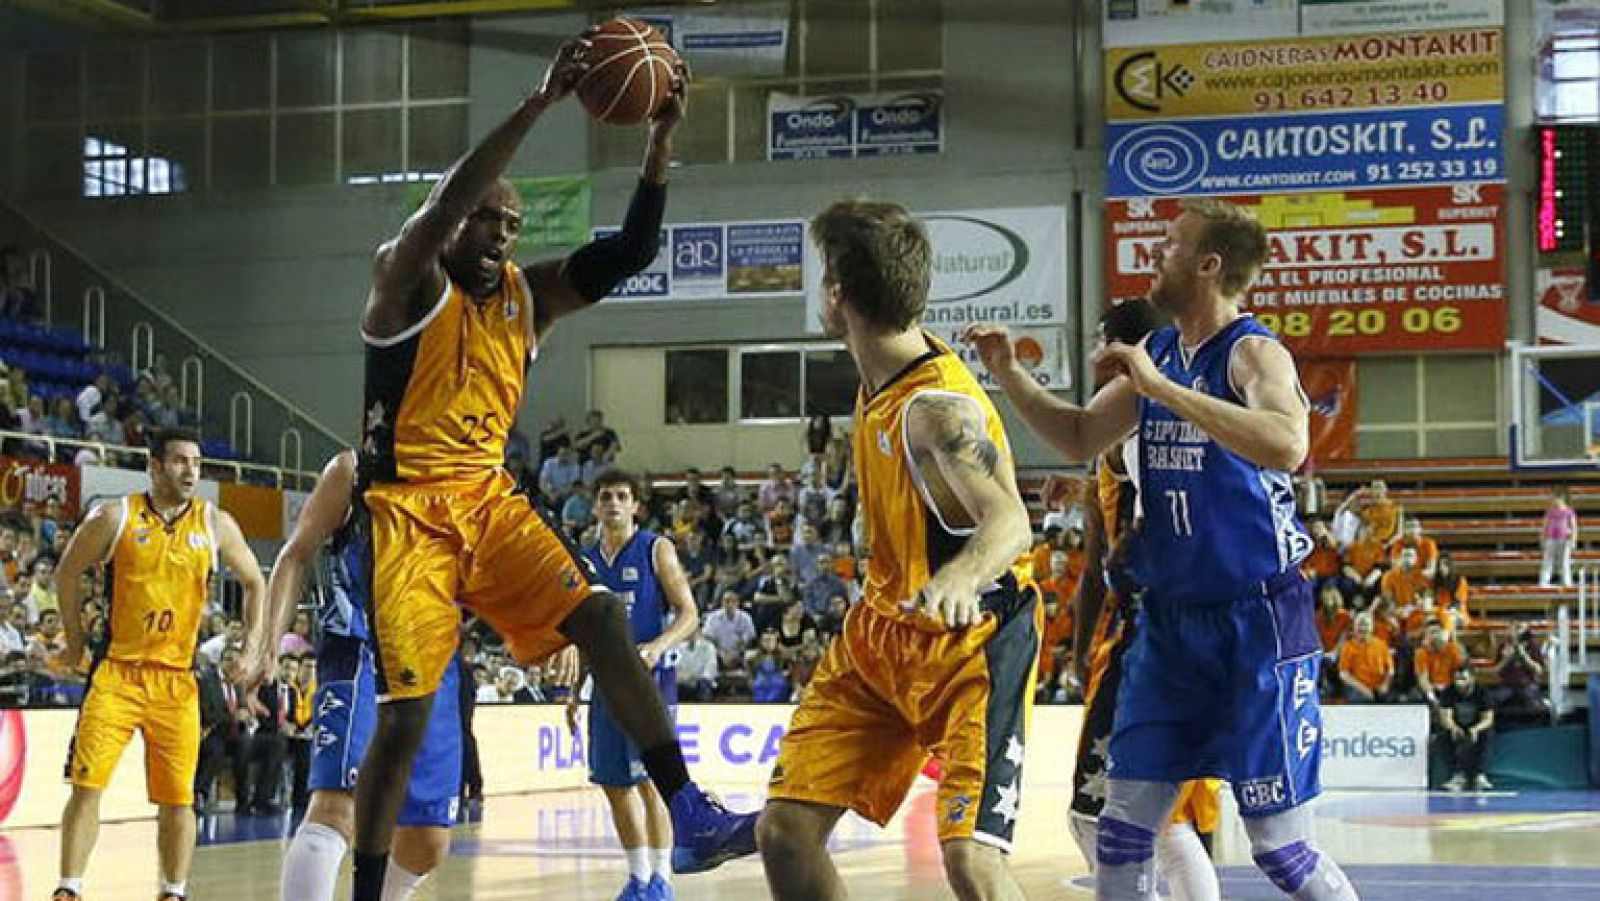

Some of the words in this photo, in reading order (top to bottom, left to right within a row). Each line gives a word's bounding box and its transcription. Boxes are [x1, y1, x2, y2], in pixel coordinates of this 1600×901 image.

[1333, 30, 1499, 61] MONTAKIT
[1205, 60, 1500, 91] www.cajonerasmontakit.com
[1255, 91, 1286, 110] 91
[1302, 86, 1354, 107] 642
[1368, 83, 1401, 105] 13
[1411, 80, 1448, 102] 40
[1201, 171, 1357, 189] WWW.CANTOSKIT.COM
[1366, 163, 1392, 182] 91
[1397, 160, 1436, 180] 252
[1440, 159, 1467, 178] 33
[1472, 157, 1498, 176] 19
[1401, 229, 1480, 258] S.L.
[1280, 270, 1304, 286] EL
[1308, 266, 1445, 285] PROFESIONAL
[1253, 291, 1277, 307] DE
[1284, 287, 1377, 306] MUEBLES
[1382, 286, 1406, 302] DE
[1414, 284, 1505, 301] COCINAS
[1328, 308, 1387, 336] 20
[1401, 306, 1462, 334] 06
[458, 412, 500, 446] 25
[143, 610, 174, 633] 10
[1241, 779, 1287, 808] GBC
